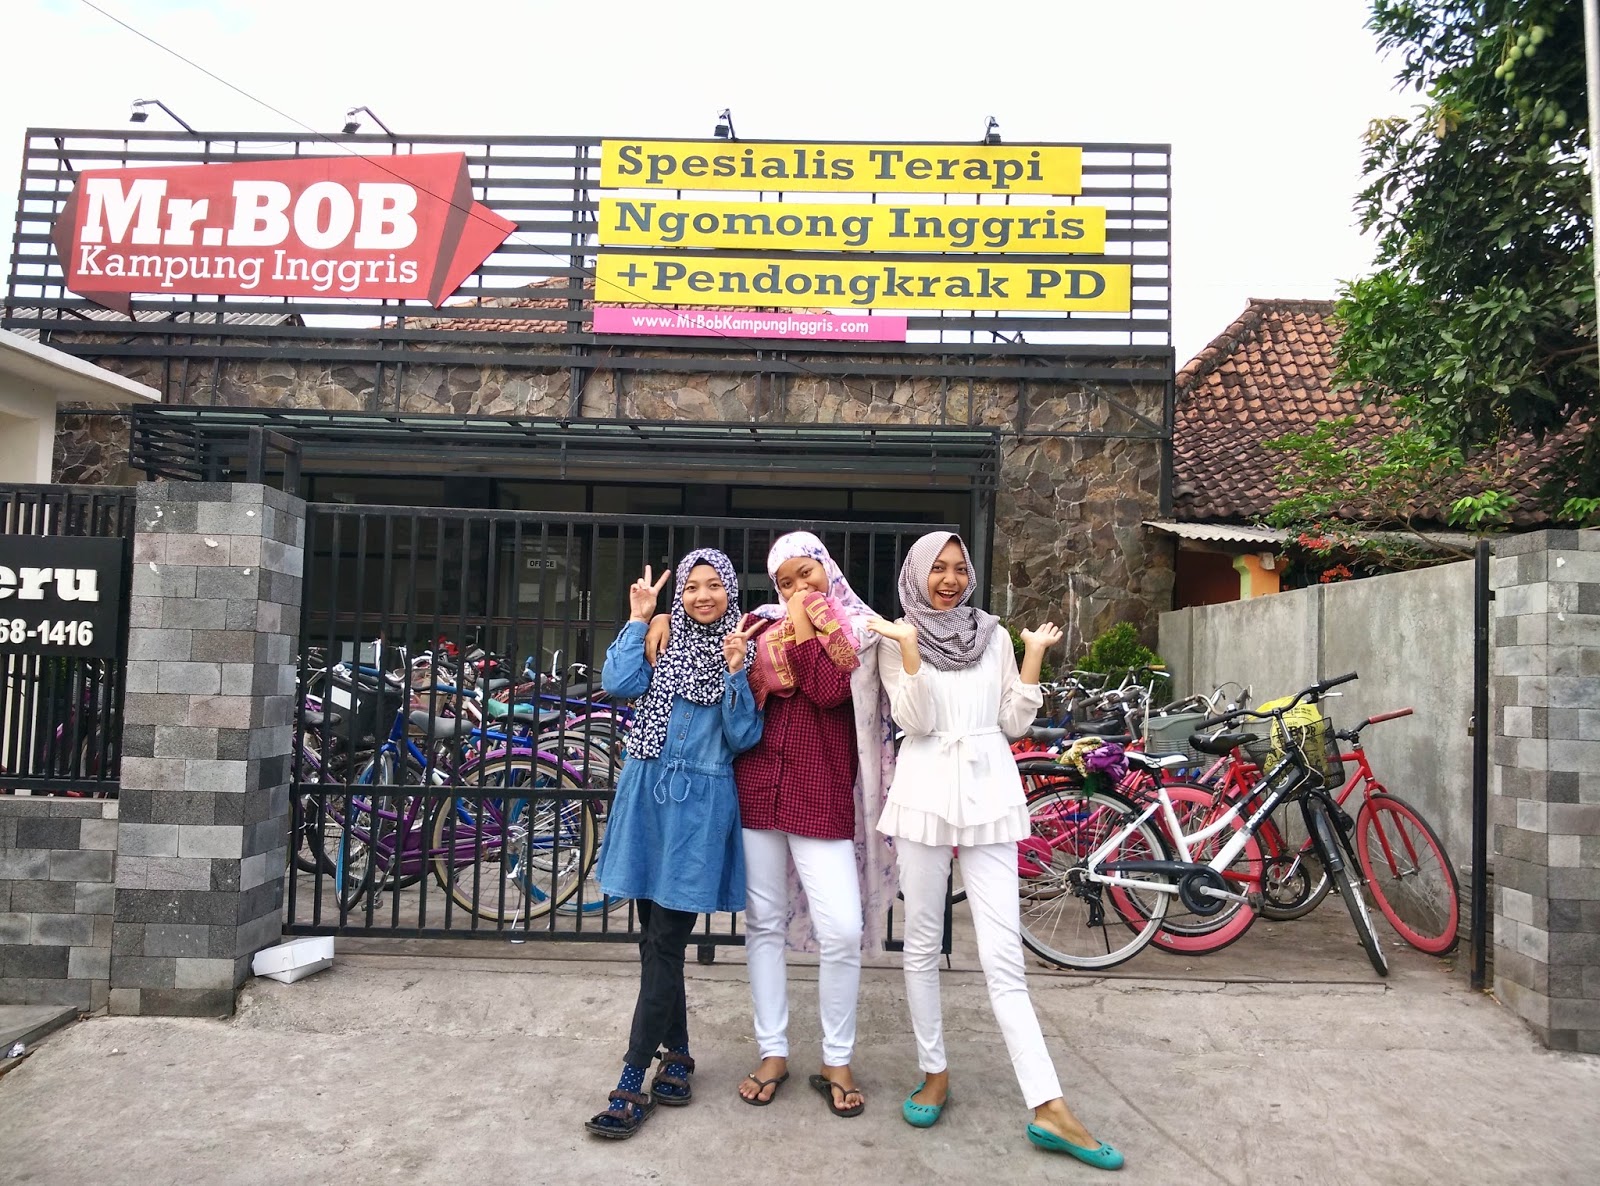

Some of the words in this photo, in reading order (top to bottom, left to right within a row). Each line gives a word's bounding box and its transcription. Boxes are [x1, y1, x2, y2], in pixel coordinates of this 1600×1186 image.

[617, 144, 855, 184] Spesialis
[868, 149, 1044, 190] Terapi
[80, 177, 418, 250] Mr.BOB
[614, 201, 874, 246] Ngomong
[888, 207, 1086, 248] Inggris
[76, 244, 265, 288] Kampung
[271, 249, 418, 292] Inggris
[616, 261, 1008, 305] +Pendongkrak
[1025, 268, 1107, 300] PD
[529, 560, 555, 568] OFFCE
